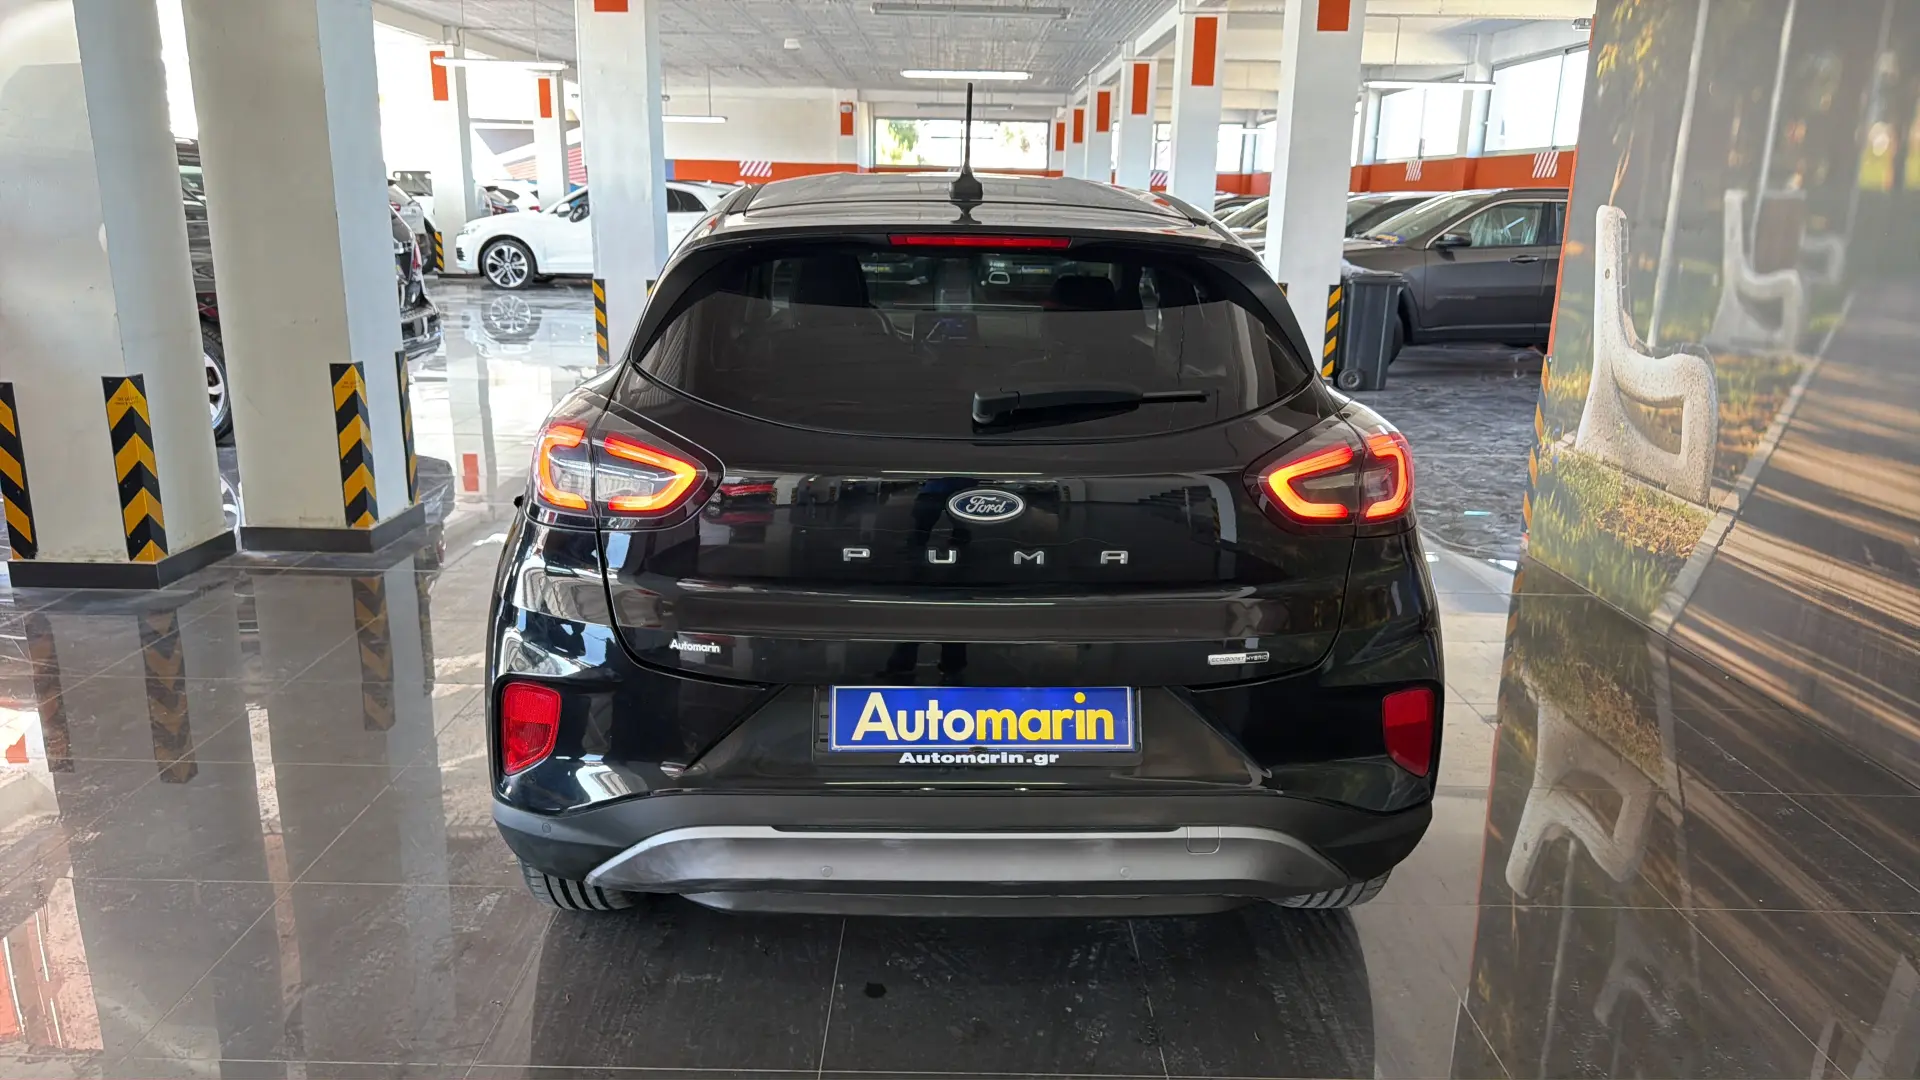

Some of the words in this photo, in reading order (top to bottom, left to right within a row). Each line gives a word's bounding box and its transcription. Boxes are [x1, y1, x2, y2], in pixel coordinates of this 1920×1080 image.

[965, 495, 1007, 513] Ford
[843, 547, 1128, 565] PUMA
[669, 639, 721, 654] Automarin
[851, 691, 1115, 741] Automarin
[899, 752, 1060, 766] Automarin.gr
